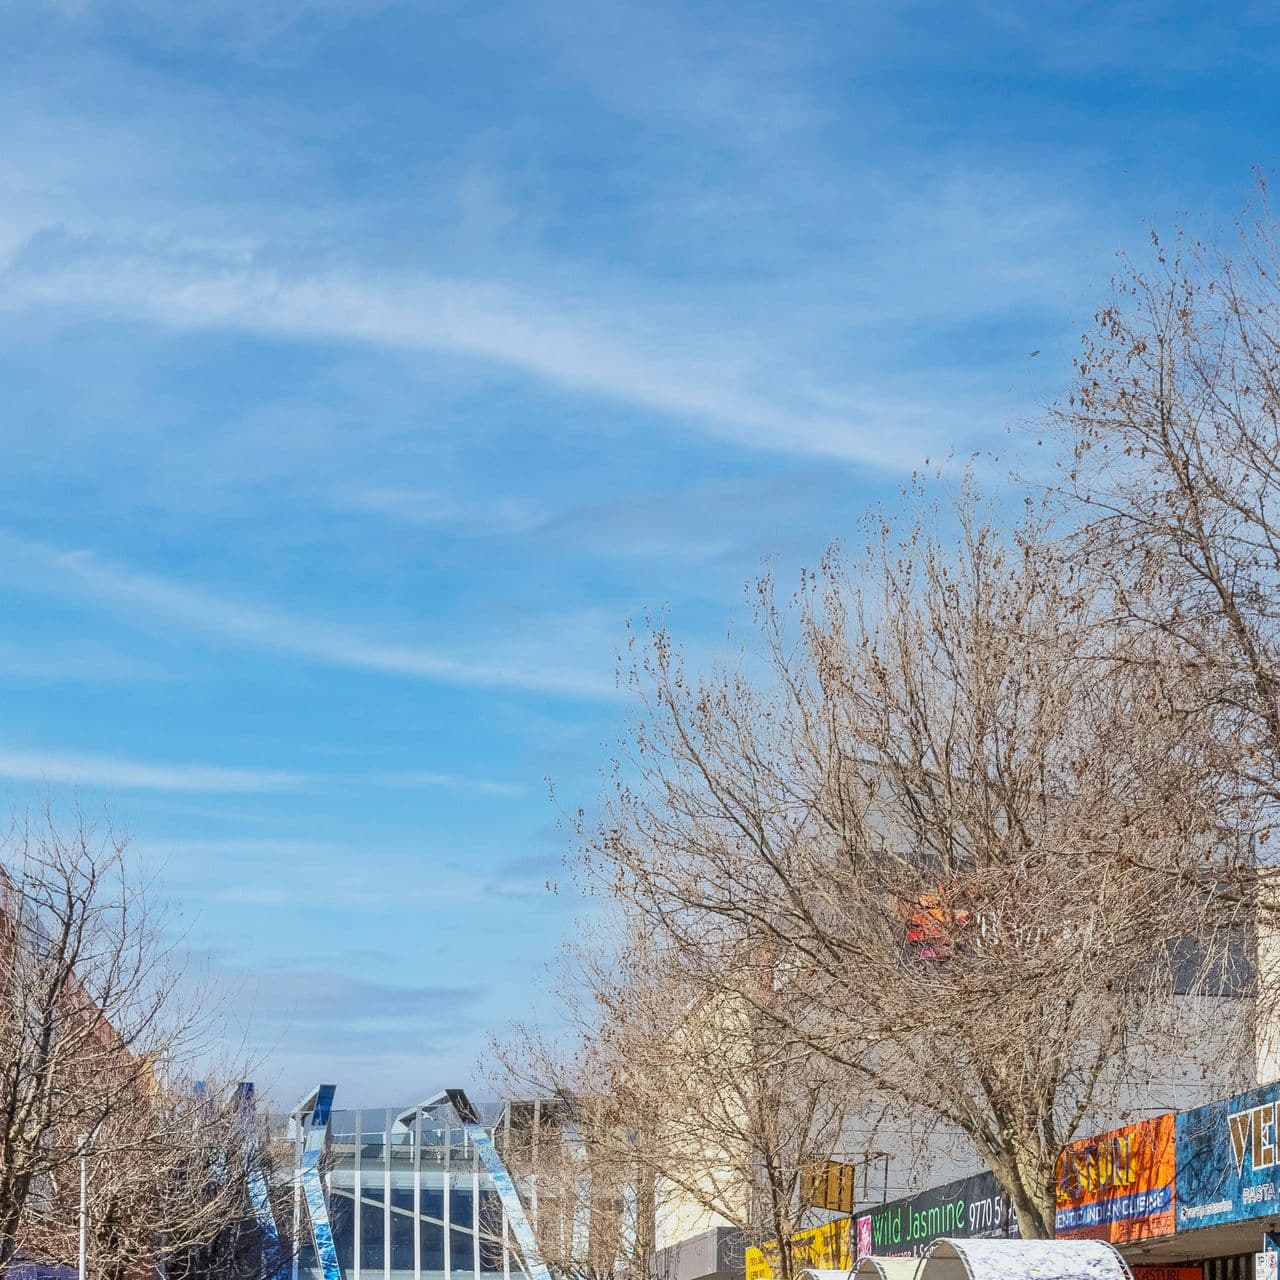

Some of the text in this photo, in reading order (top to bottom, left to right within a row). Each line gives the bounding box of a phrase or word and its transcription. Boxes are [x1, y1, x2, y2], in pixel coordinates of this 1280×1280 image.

[1242, 1183, 1276, 1205] PASTA
[873, 1207, 901, 1247] Wild
[906, 1196, 966, 1241] Jasmine
[969, 1198, 992, 1231] 9770
